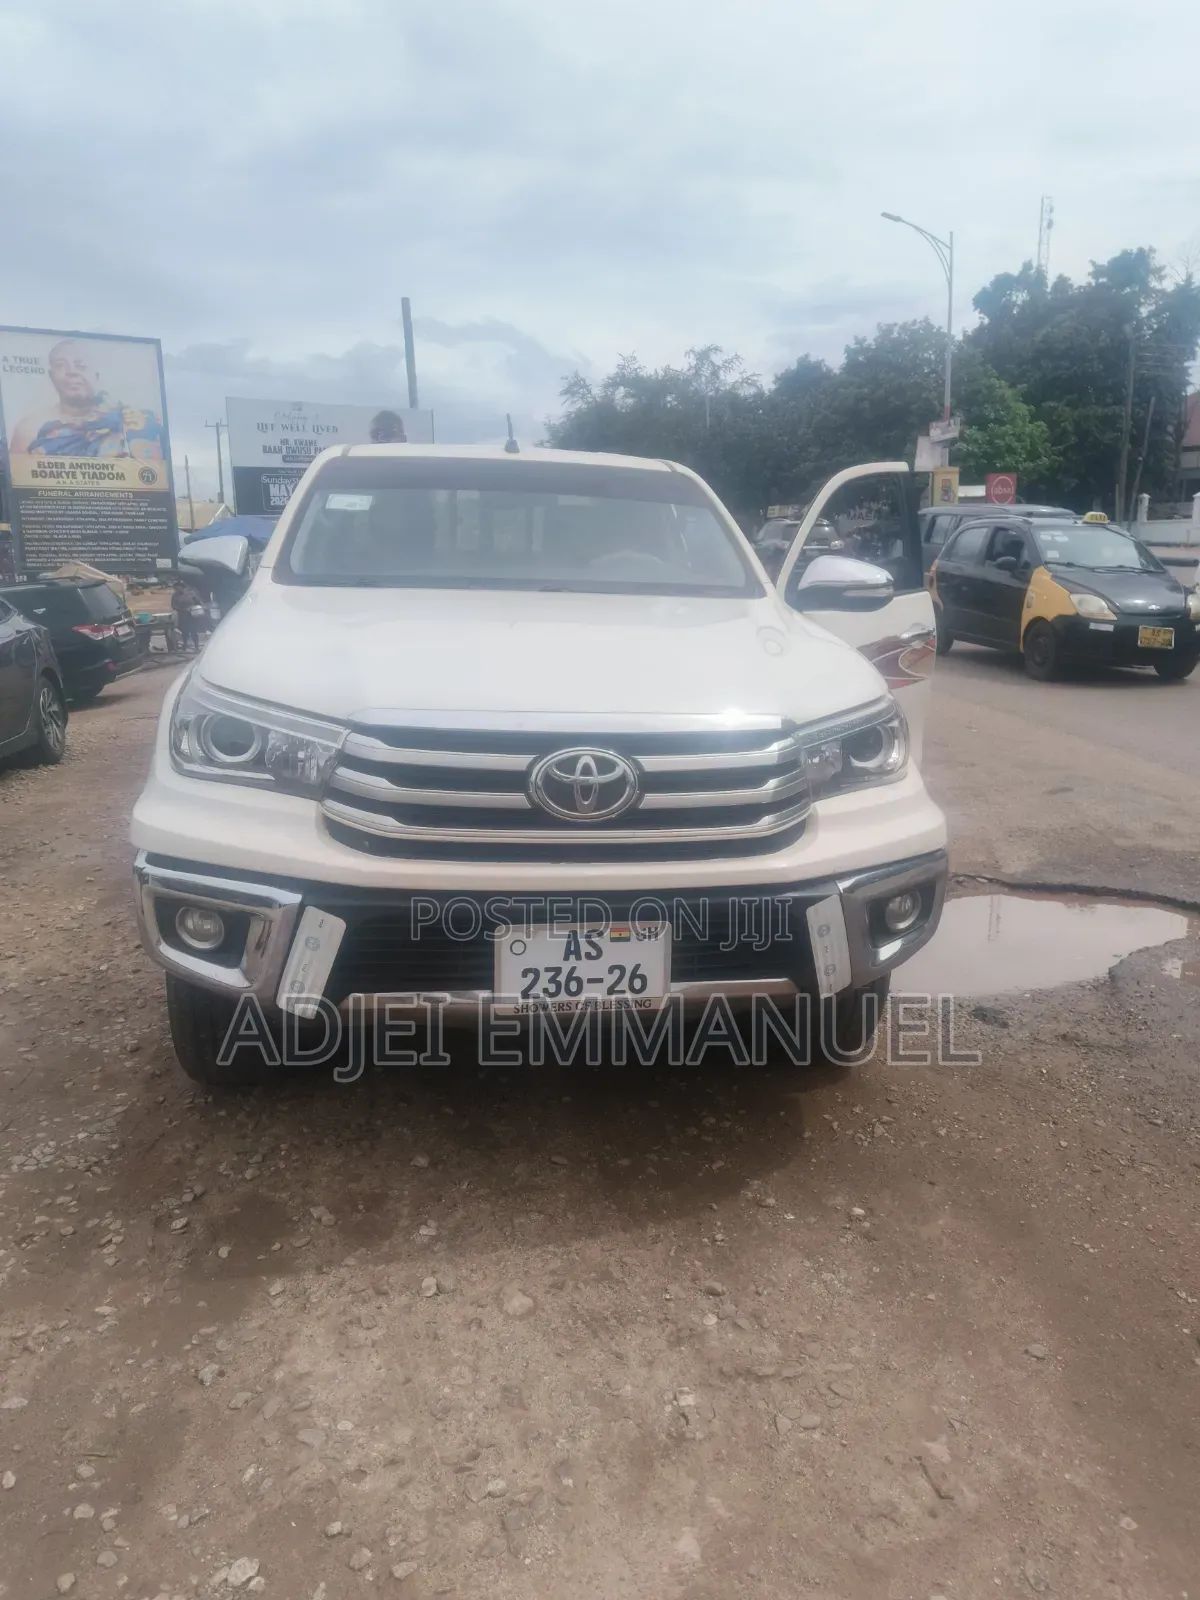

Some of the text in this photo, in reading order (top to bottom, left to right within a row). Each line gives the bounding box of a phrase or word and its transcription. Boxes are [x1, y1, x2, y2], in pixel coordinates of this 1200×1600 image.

[12, 355, 41, 365] TRUE
[3, 364, 46, 375] LEGEND
[37, 460, 116, 472] ELDER ANTHONY
[31, 469, 126, 481] BOAKYE YIADOM
[261, 475, 292, 485] Sunday
[38, 489, 134, 499] FUNERAL ARRANGEMENTS
[269, 483, 294, 497] MAY
[562, 928, 604, 962] AS
[520, 963, 648, 1000] 236-26
[513, 1001, 573, 1014] SHOWERS
